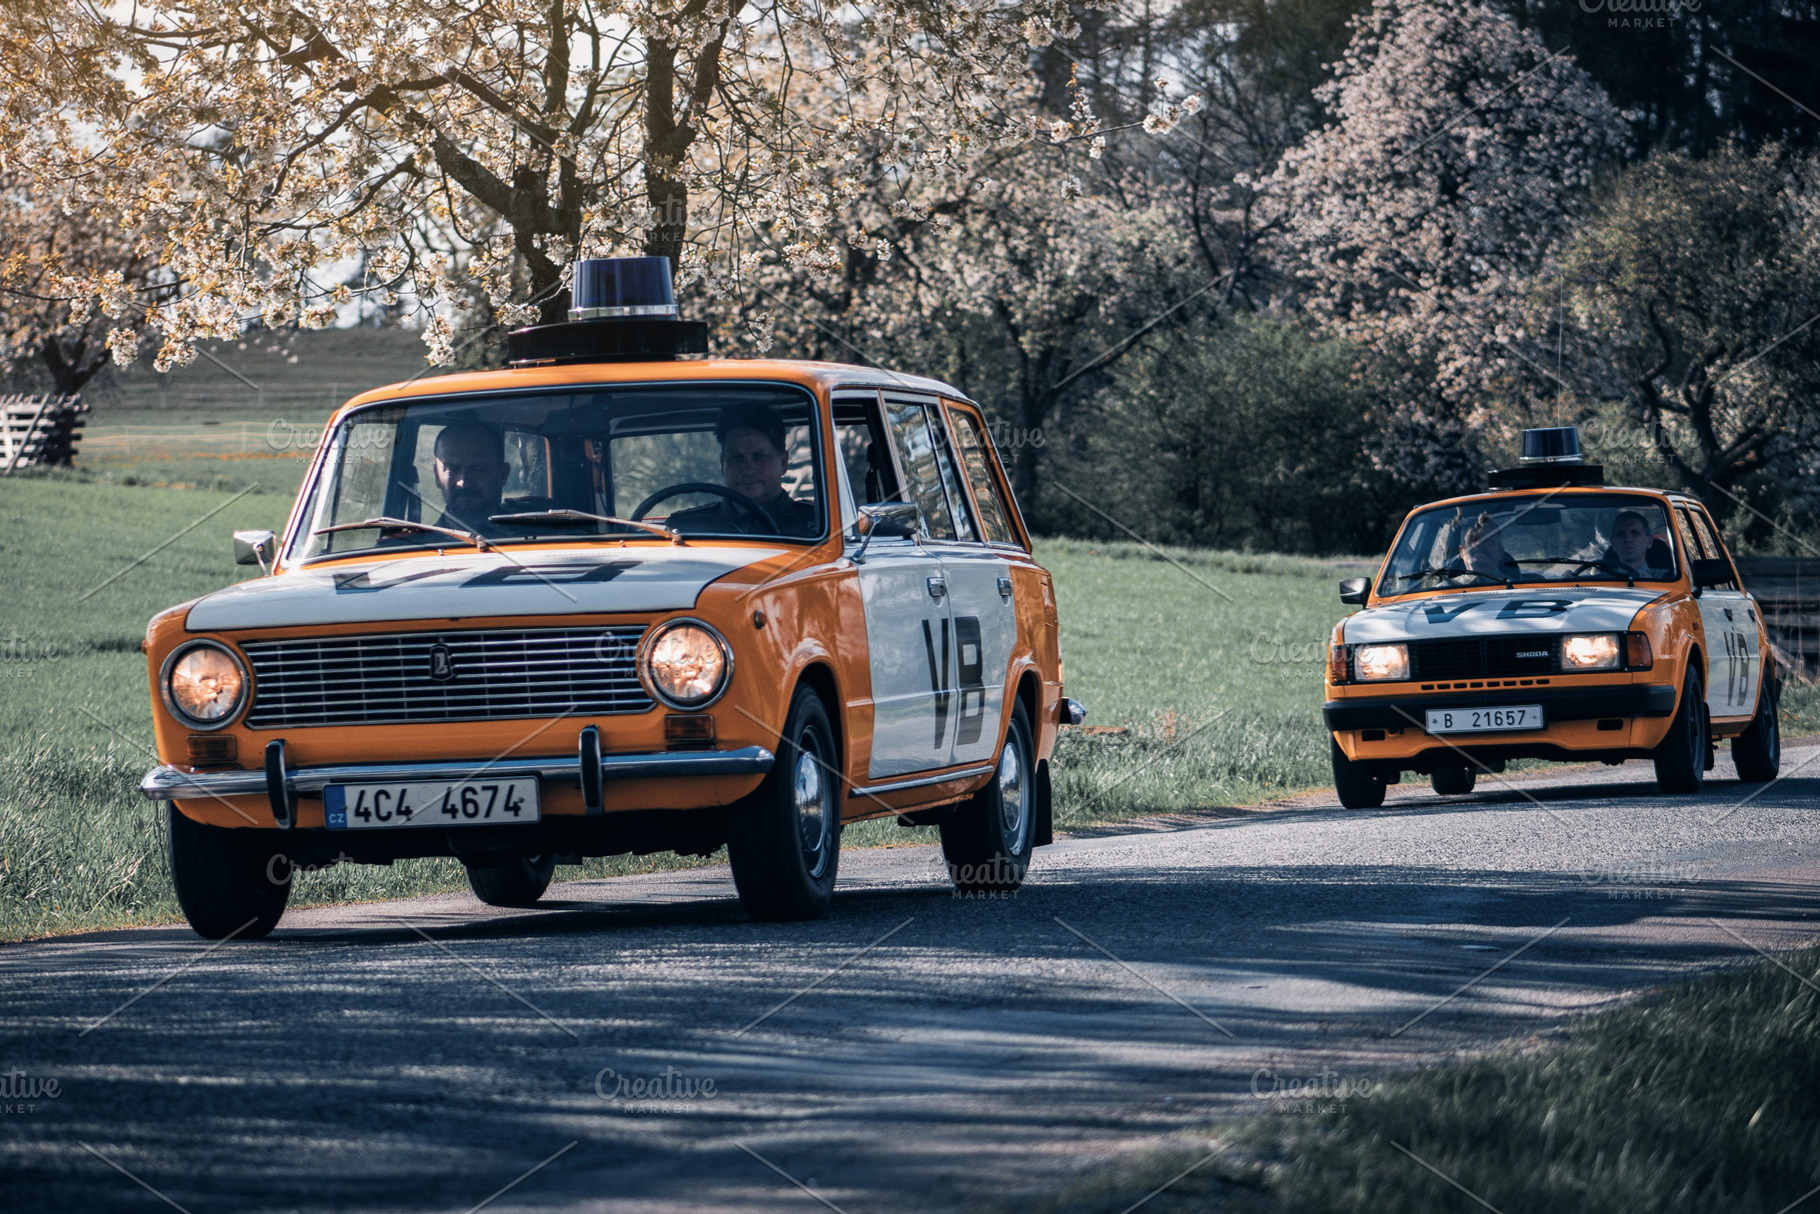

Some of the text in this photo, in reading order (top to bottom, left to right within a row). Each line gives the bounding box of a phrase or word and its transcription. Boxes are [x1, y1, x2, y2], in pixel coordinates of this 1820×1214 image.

[1423, 600, 1574, 624] VB
[921, 616, 986, 750] VB
[1723, 632, 1750, 706] VB
[1444, 710, 1526, 728] B 21657
[329, 813, 345, 824] CZ
[354, 784, 522, 823] 4C4 4674
